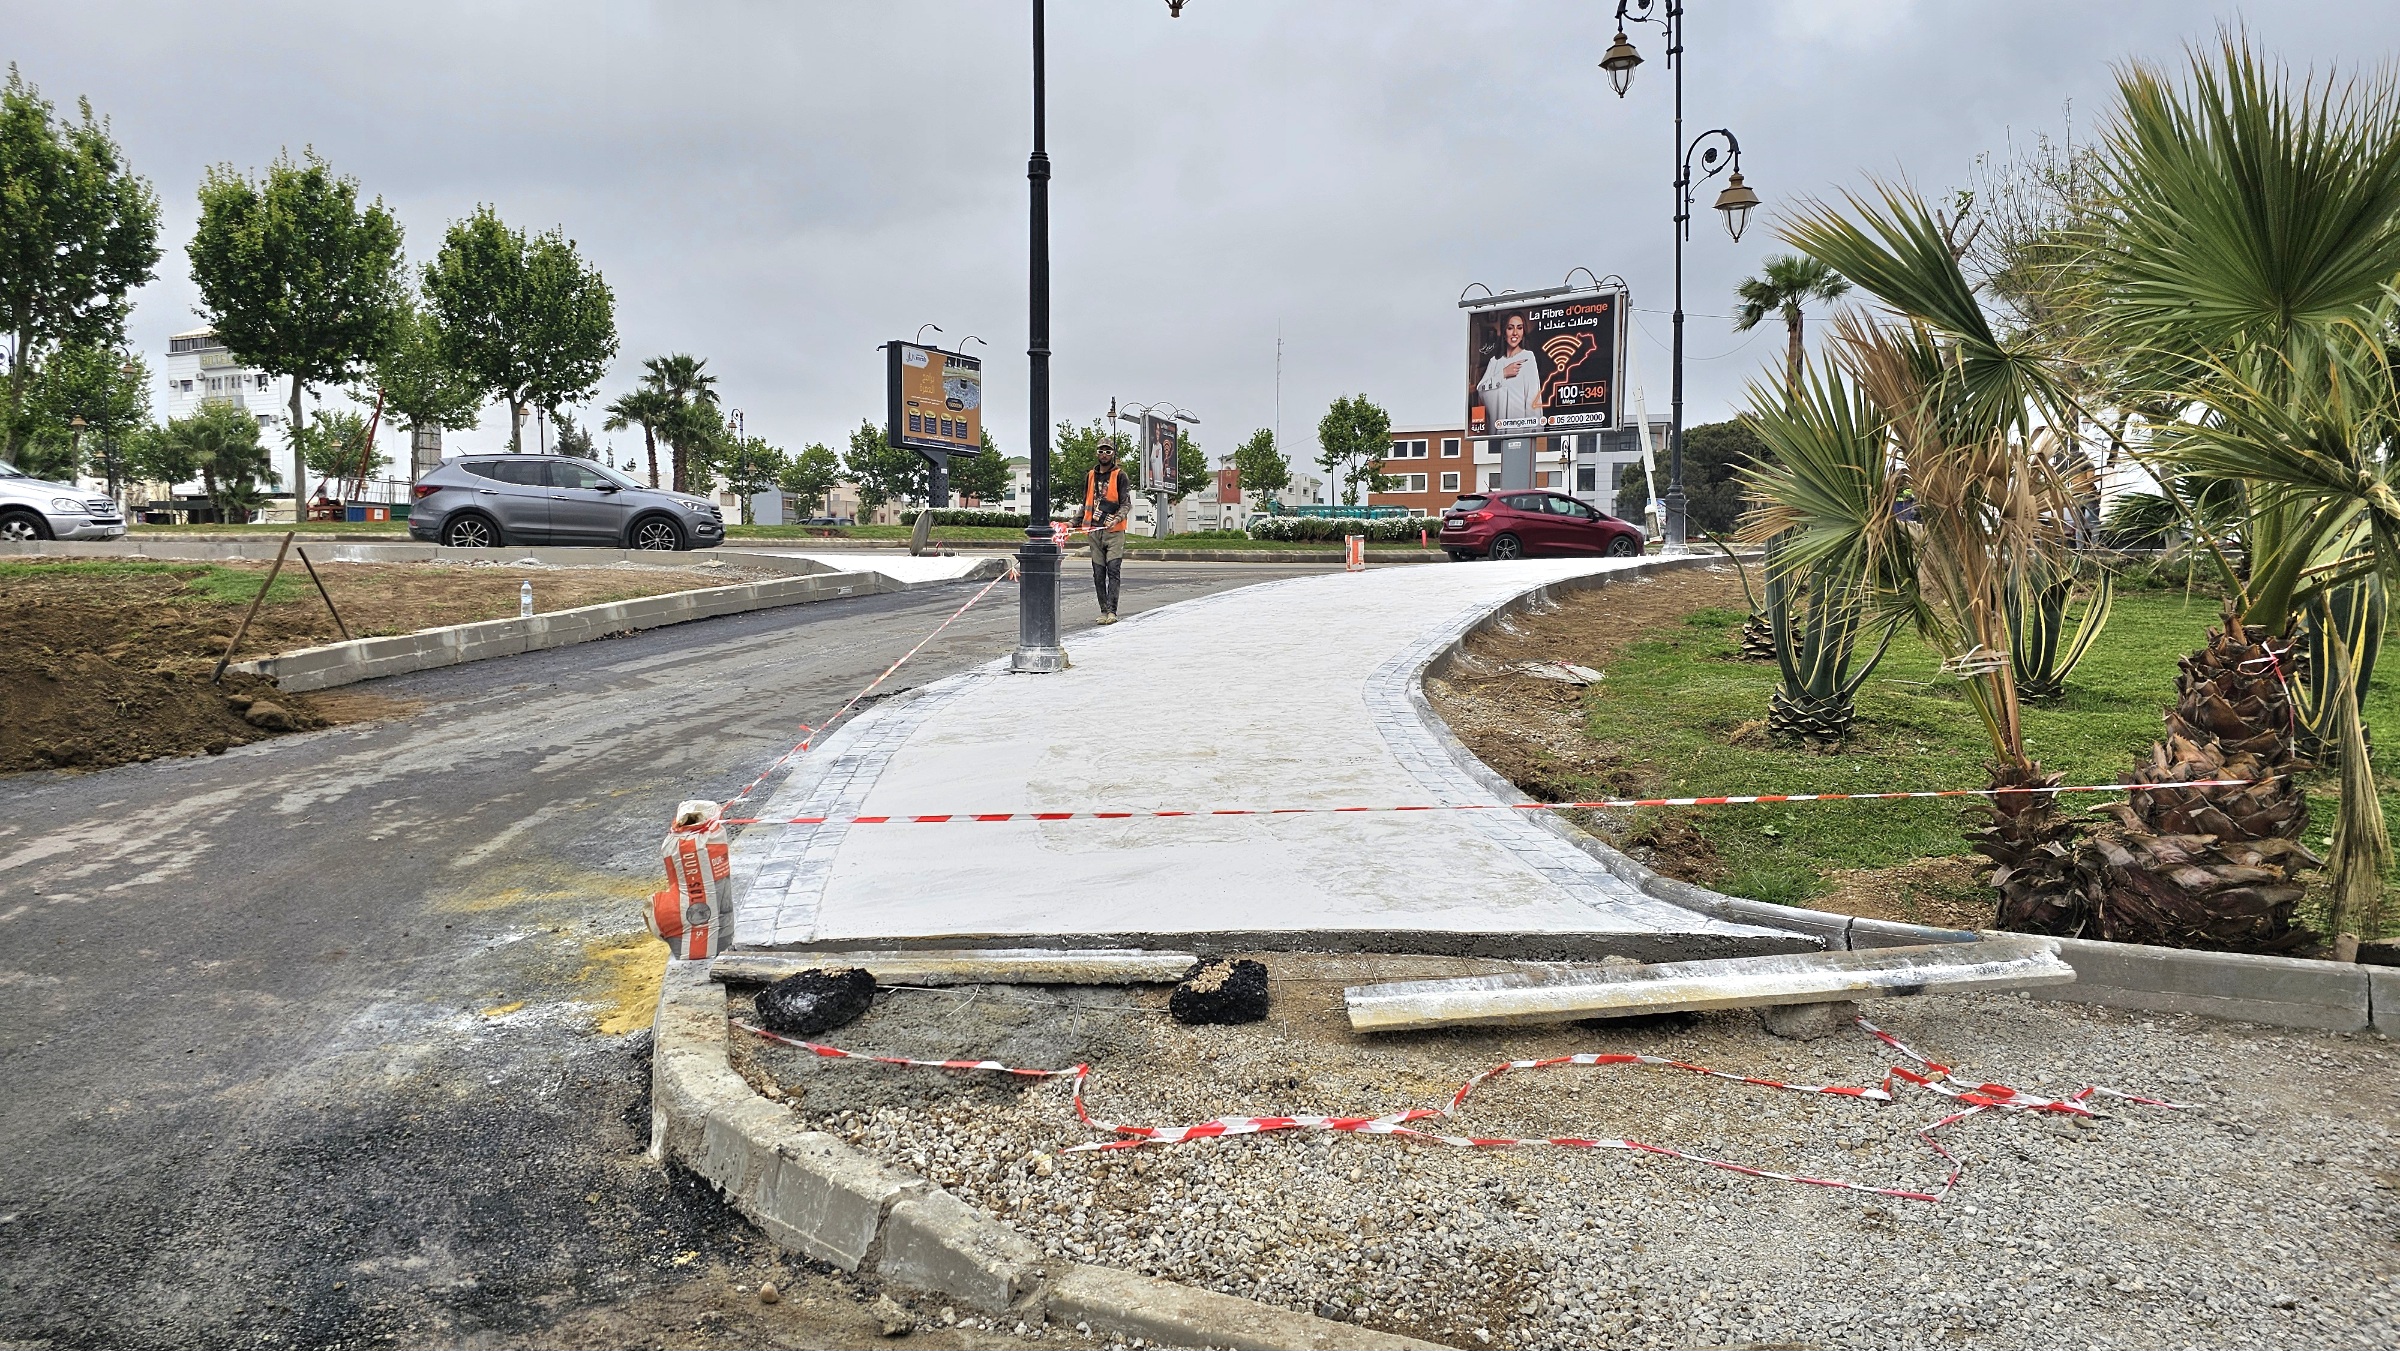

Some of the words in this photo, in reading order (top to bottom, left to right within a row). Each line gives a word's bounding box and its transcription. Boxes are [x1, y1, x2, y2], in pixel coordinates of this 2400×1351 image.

[1529, 311, 1540, 320] La
[1541, 308, 1564, 319] Fibre
[1565, 303, 1608, 316] d'Orange
[1543, 320, 1566, 330] عندك
[1568, 315, 1598, 327] وصلات
[202, 354, 232, 366] HOTEL
[1558, 385, 1578, 399] 100
[1584, 386, 1604, 398] 349
[1502, 418, 1537, 427] orange.ma
[1556, 416, 1565, 424] 05
[1566, 414, 1584, 423] 2000
[1585, 413, 1603, 422] 2000
